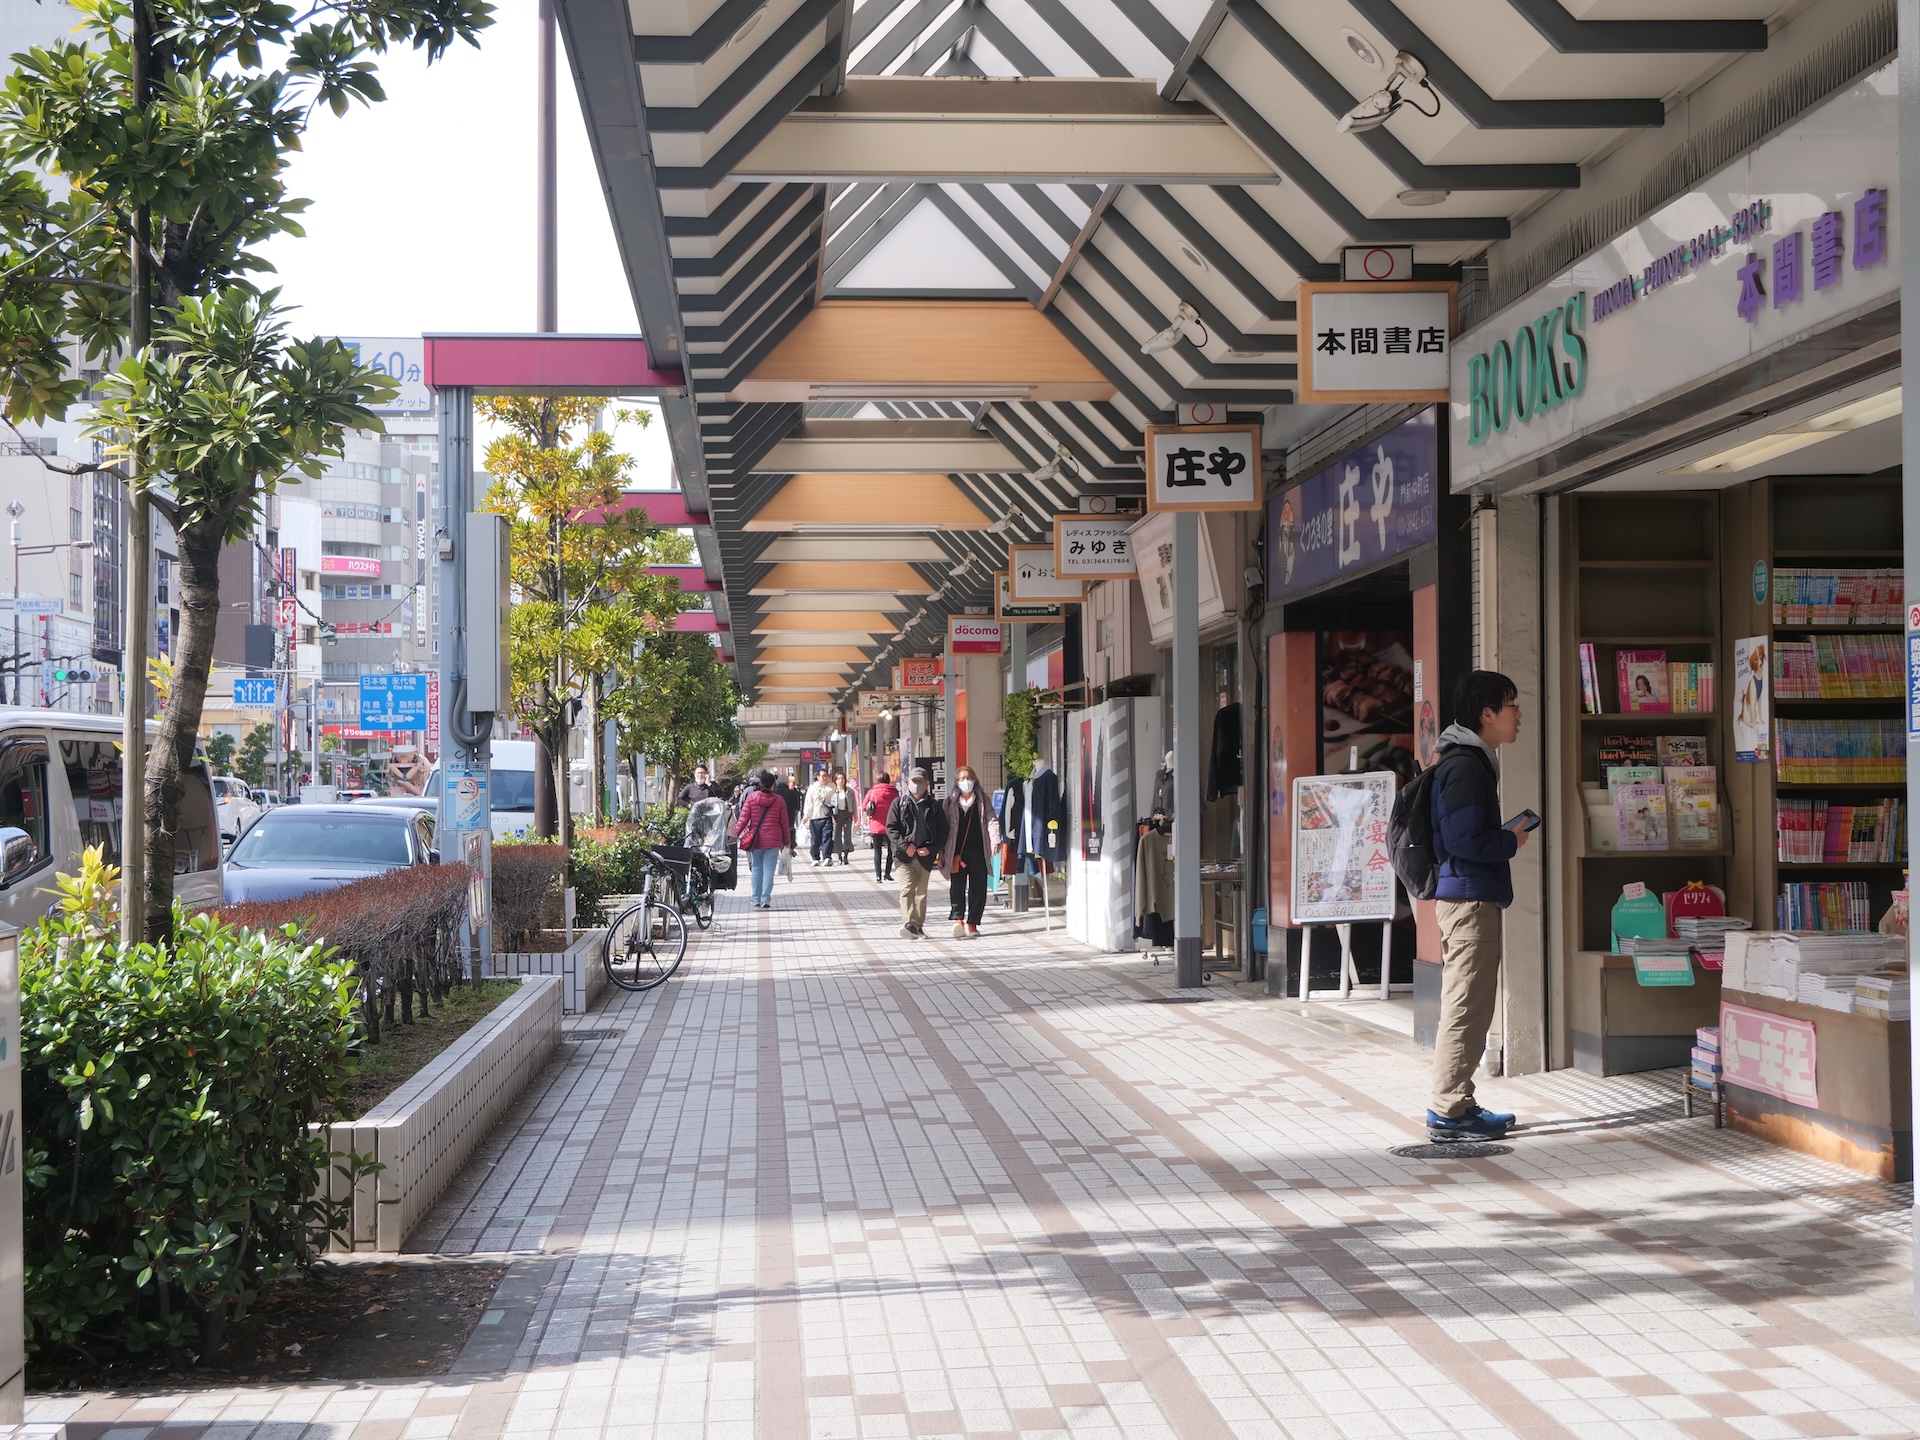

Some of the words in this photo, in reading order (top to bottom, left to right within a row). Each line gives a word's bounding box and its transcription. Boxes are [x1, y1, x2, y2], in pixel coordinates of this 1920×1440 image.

[1643, 244, 1685, 296] PHONE
[1737, 188, 1888, 323] 本間書店
[1316, 326, 1446, 356] 本間書店
[1468, 291, 1588, 447] BOOKS
[1166, 446, 1247, 488] 庄や
[1400, 472, 1430, 507] 門前仲町店
[339, 508, 379, 520] TOMAS
[1338, 444, 1395, 570] 庄や
[417, 518, 426, 560] TOMAS
[1300, 507, 1334, 553] くつろぎの里
[1069, 540, 1127, 555] みゆき
[347, 560, 376, 572] ハウスメイト
[955, 624, 999, 635] docomo
[362, 677, 388, 685] 日本橋
[391, 677, 417, 685] 永代橋
[908, 664, 935, 674] こころ
[362, 701, 381, 709] 月島
[430, 682, 439, 739] くすりの福太郎
[1600, 749, 1621, 760] Hotel
[1621, 749, 1652, 761] Wedding
[1603, 737, 1623, 746] Hotel
[1624, 737, 1655, 747] Wedding
[1667, 741, 1699, 750] ベビー用品
[1365, 820, 1391, 873] 宴会
[1683, 892, 1711, 905] ゼクシィ
[1724, 1014, 1740, 1073] 小学
[1737, 1022, 1814, 1097] 一年生
